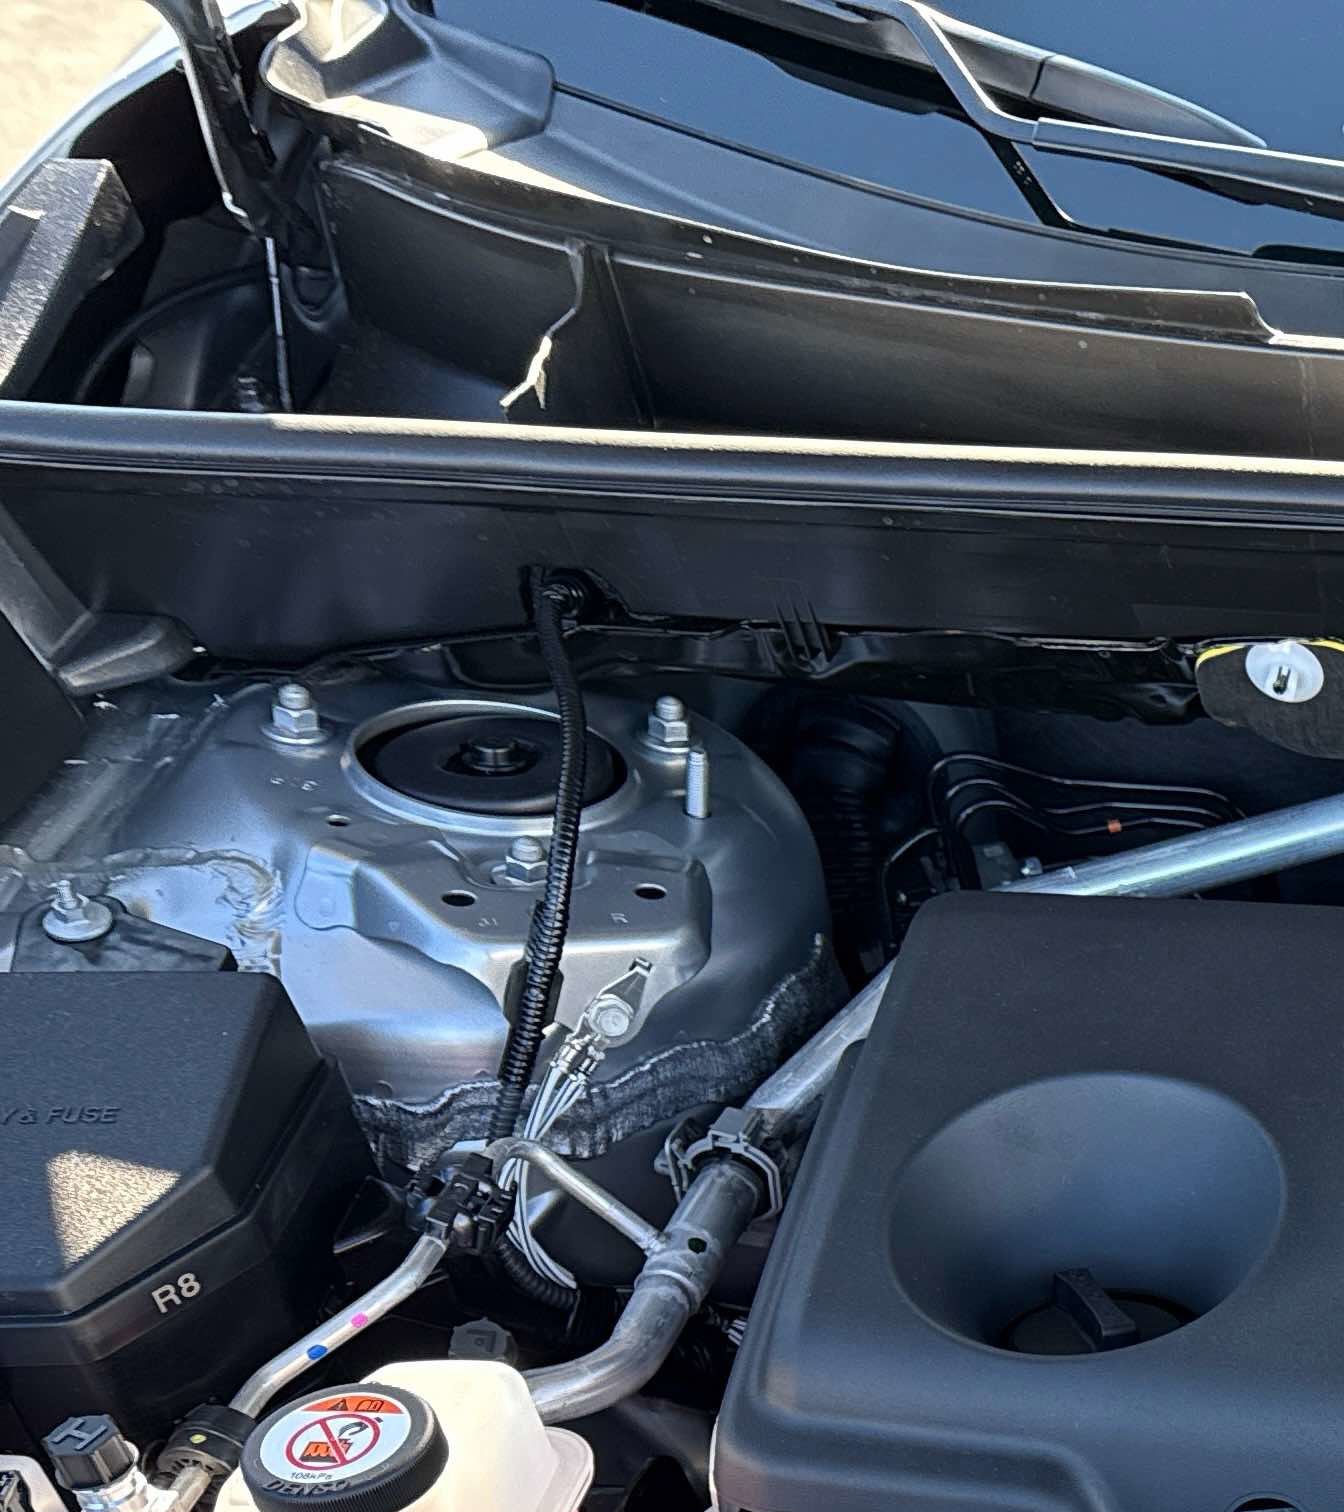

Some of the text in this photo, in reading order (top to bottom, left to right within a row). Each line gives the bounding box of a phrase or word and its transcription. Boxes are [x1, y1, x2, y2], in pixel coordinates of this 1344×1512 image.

[46, 1106, 122, 1125] FUSE
[152, 1272, 201, 1314] R8
[289, 1471, 334, 1481] 108kPa
[262, 1480, 351, 1497] DENSO
